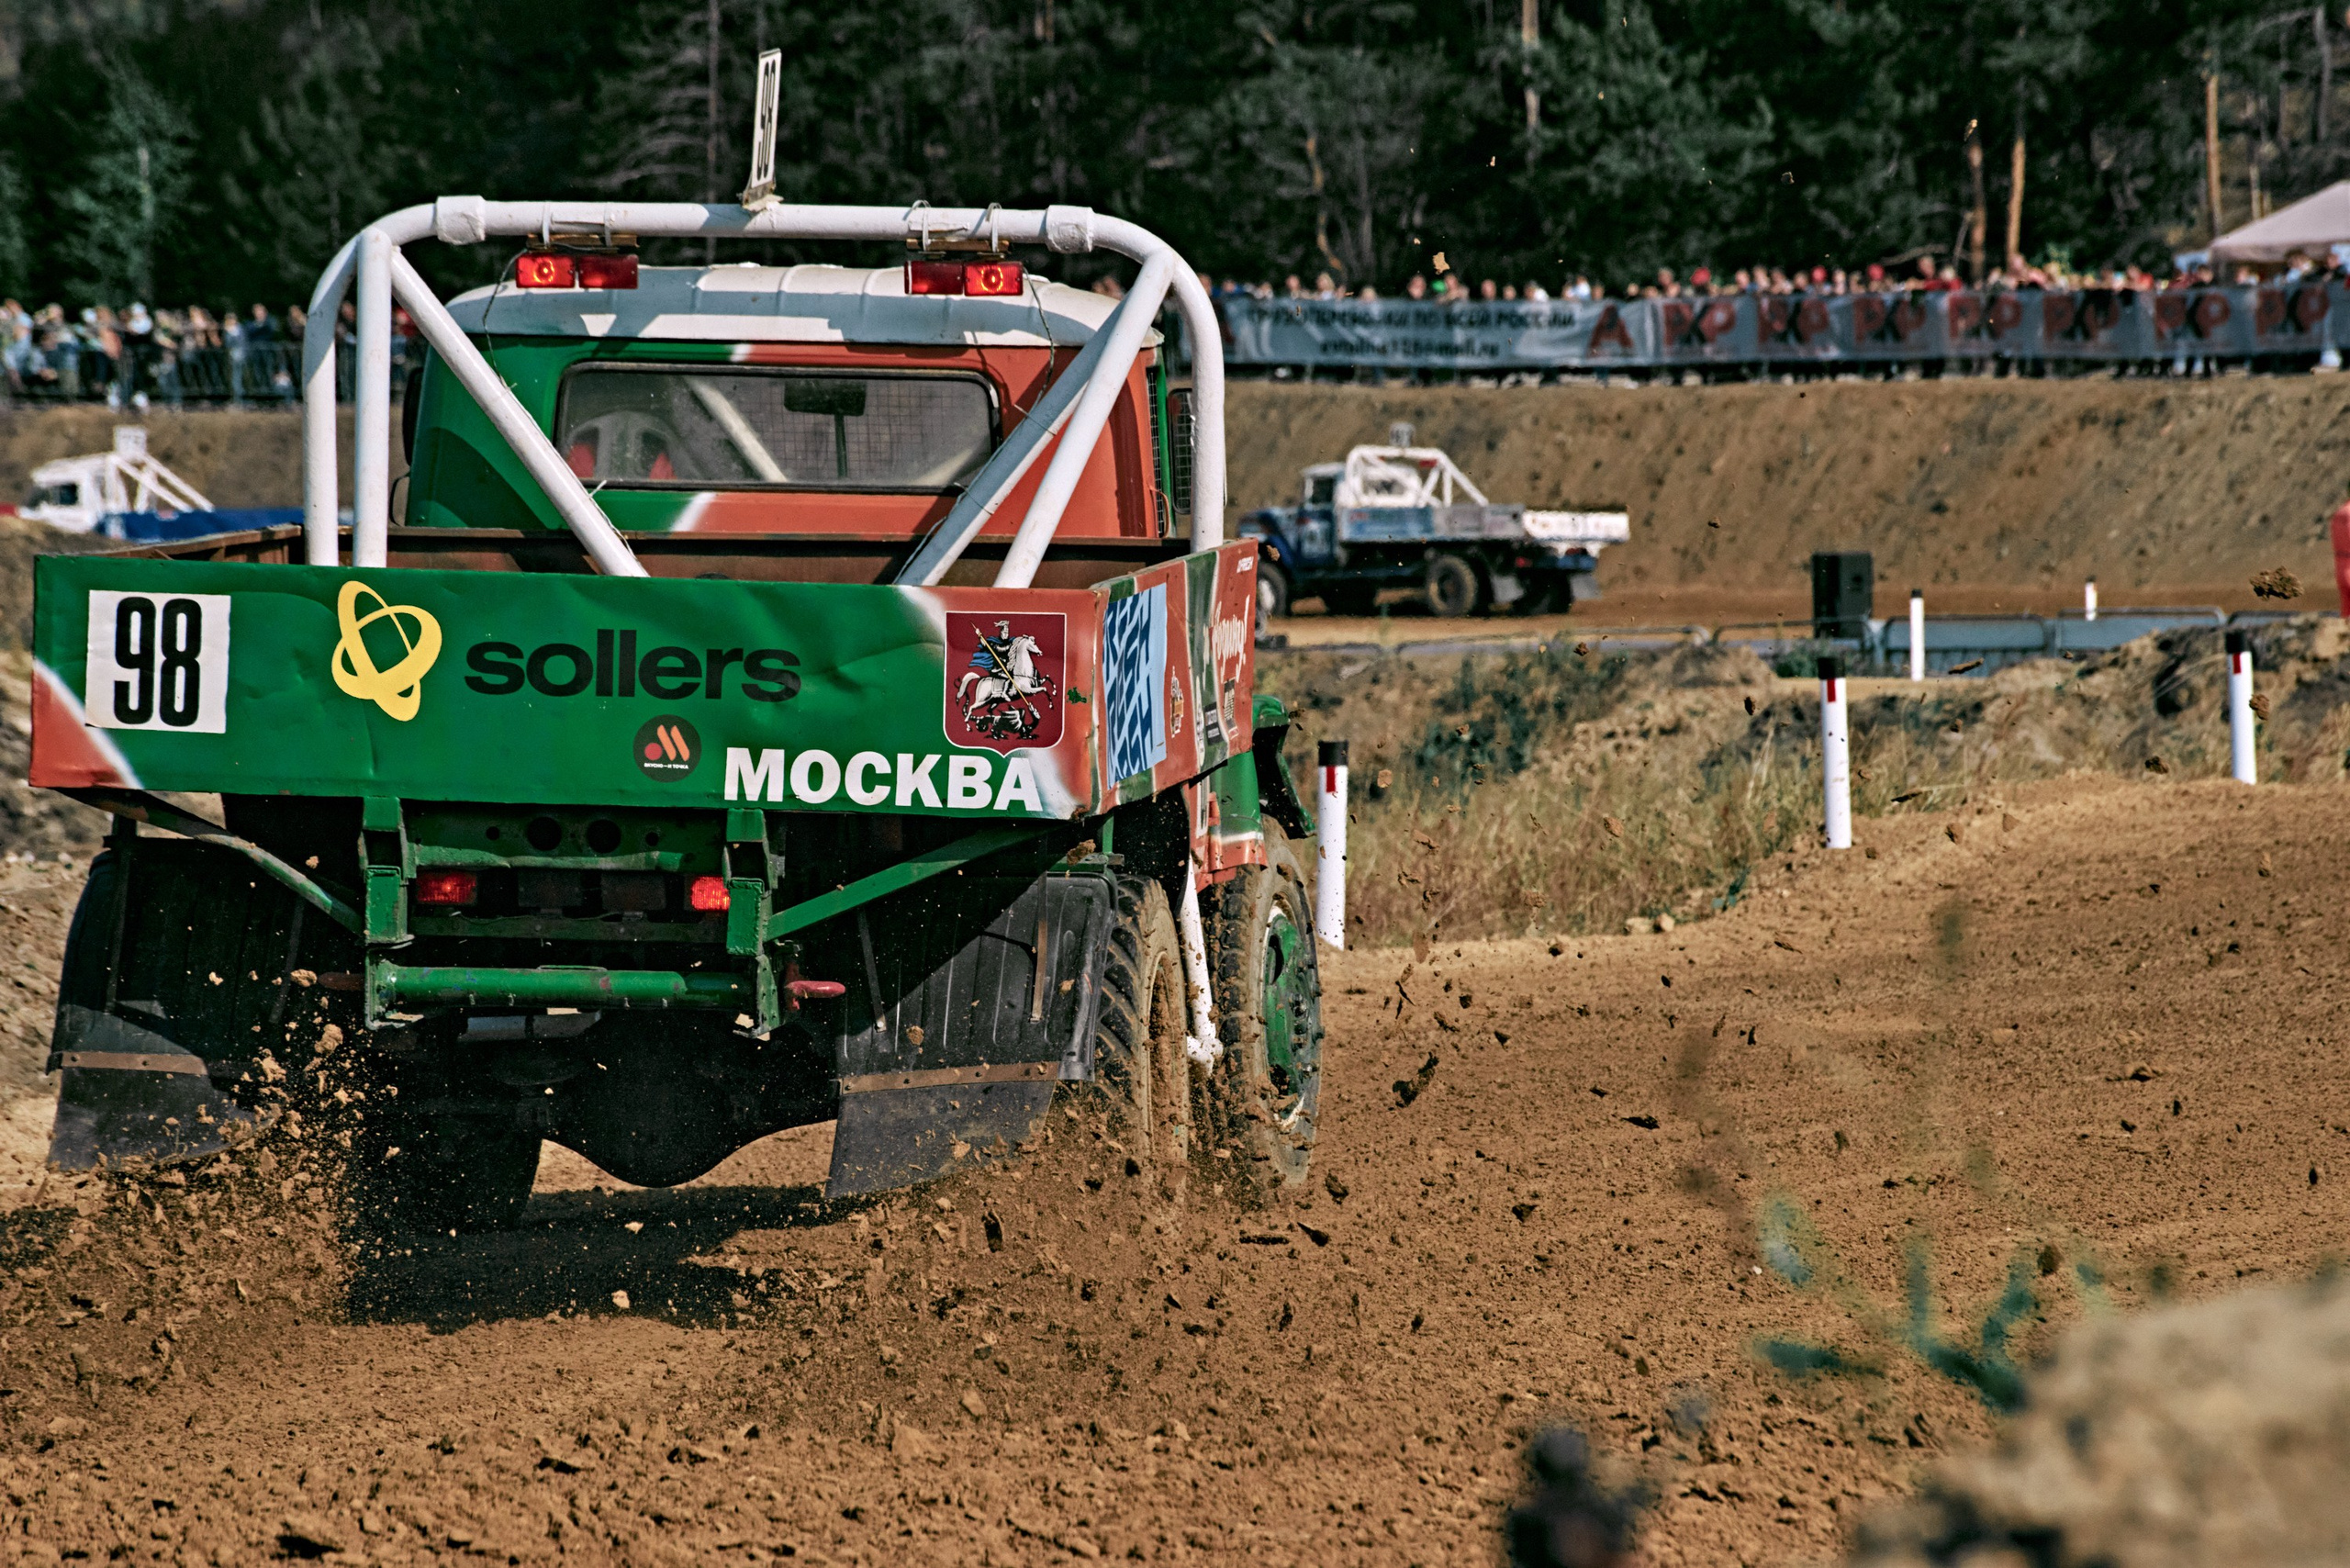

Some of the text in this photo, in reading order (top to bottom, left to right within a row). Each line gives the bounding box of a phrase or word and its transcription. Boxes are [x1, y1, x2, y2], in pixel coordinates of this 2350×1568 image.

[113, 596, 203, 727] 98
[464, 628, 800, 702] sollers
[724, 747, 1043, 812] МОСКВА
